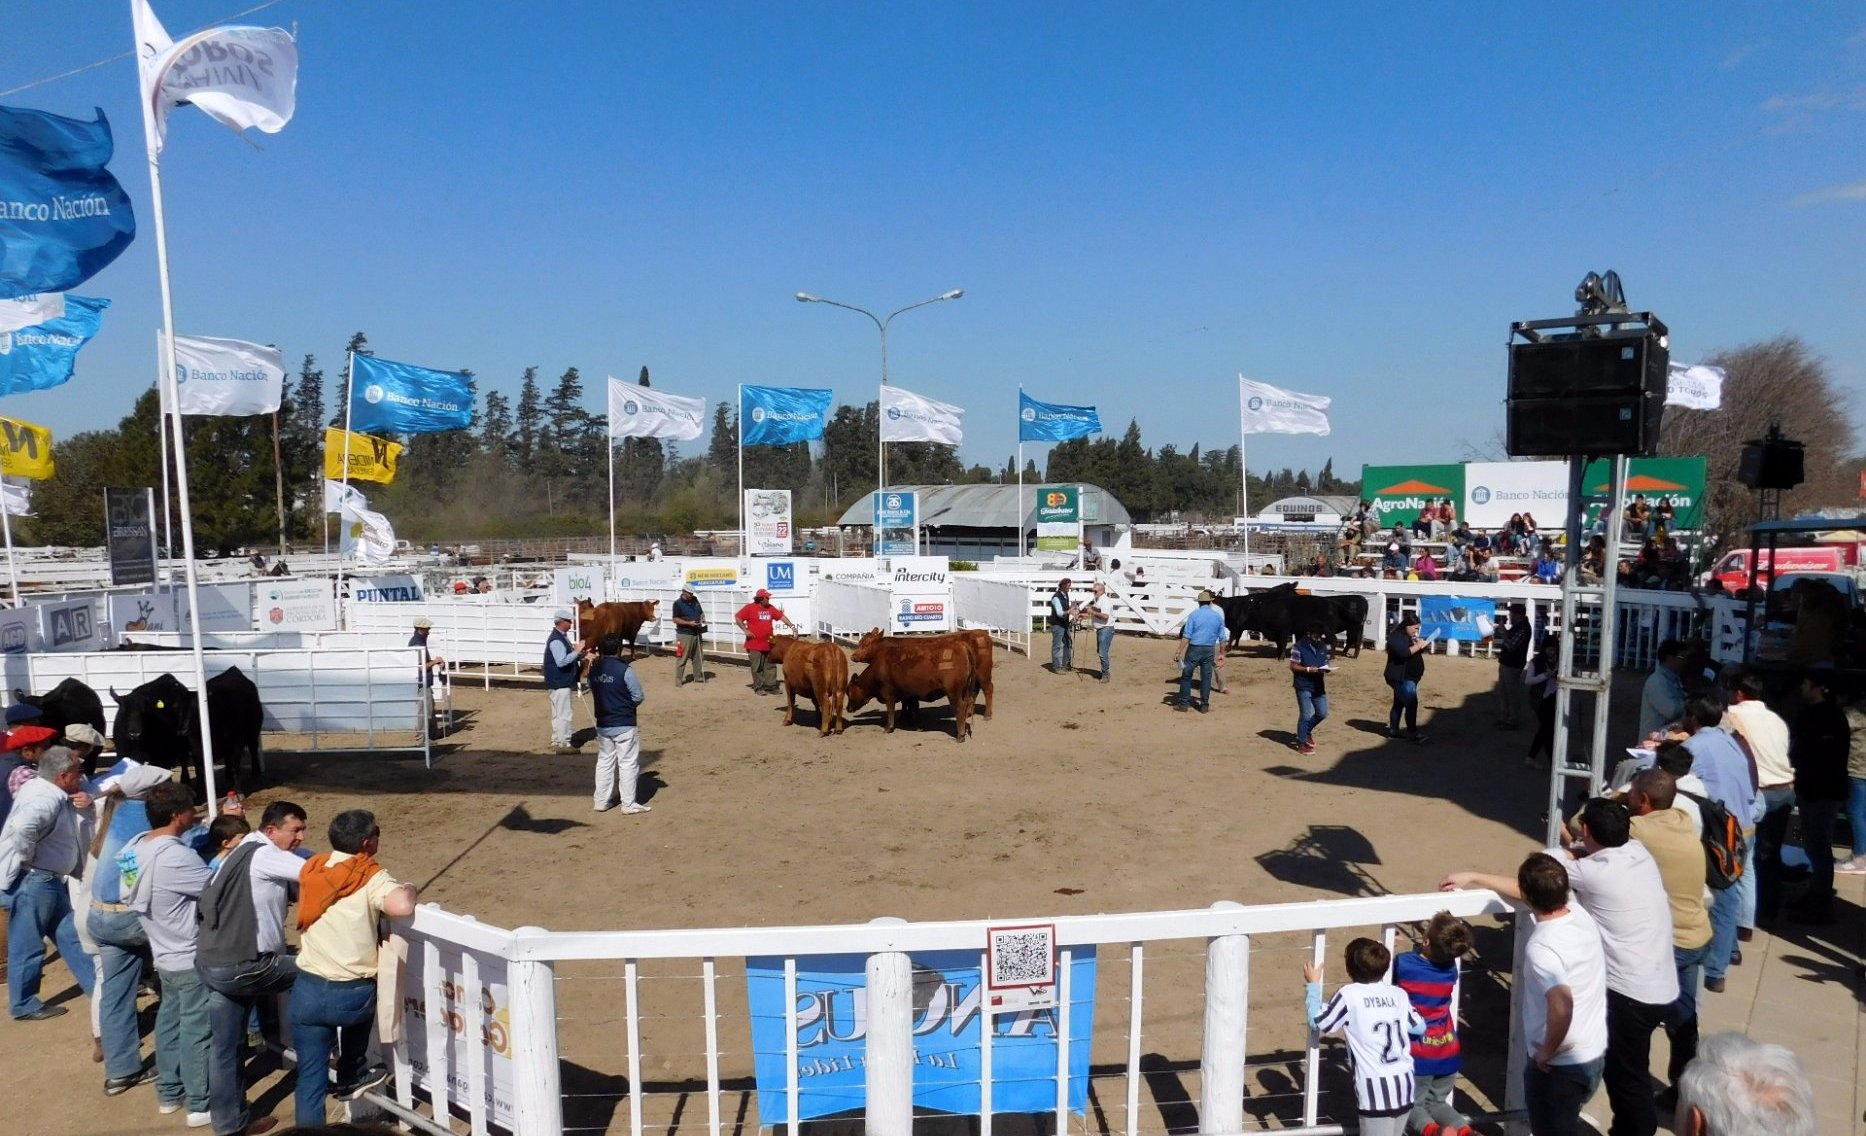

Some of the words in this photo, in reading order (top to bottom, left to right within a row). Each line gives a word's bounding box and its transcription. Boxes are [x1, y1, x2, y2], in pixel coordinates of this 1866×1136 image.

[0, 201, 49, 221] anco
[53, 192, 110, 221] Nación
[191, 369, 227, 381] Banco
[387, 392, 420, 404] Banco
[422, 397, 459, 412] Nación
[642, 405, 667, 415] Banco
[1495, 490, 1530, 501] Banco
[1275, 504, 1322, 513] EQUINOS
[768, 566, 792, 580] UM
[894, 567, 946, 584] intercity
[568, 573, 592, 590] bio4
[355, 586, 420, 602] PUNTAL
[1363, 997, 1398, 1009] DYBALA
[1373, 1019, 1406, 1064] 21
